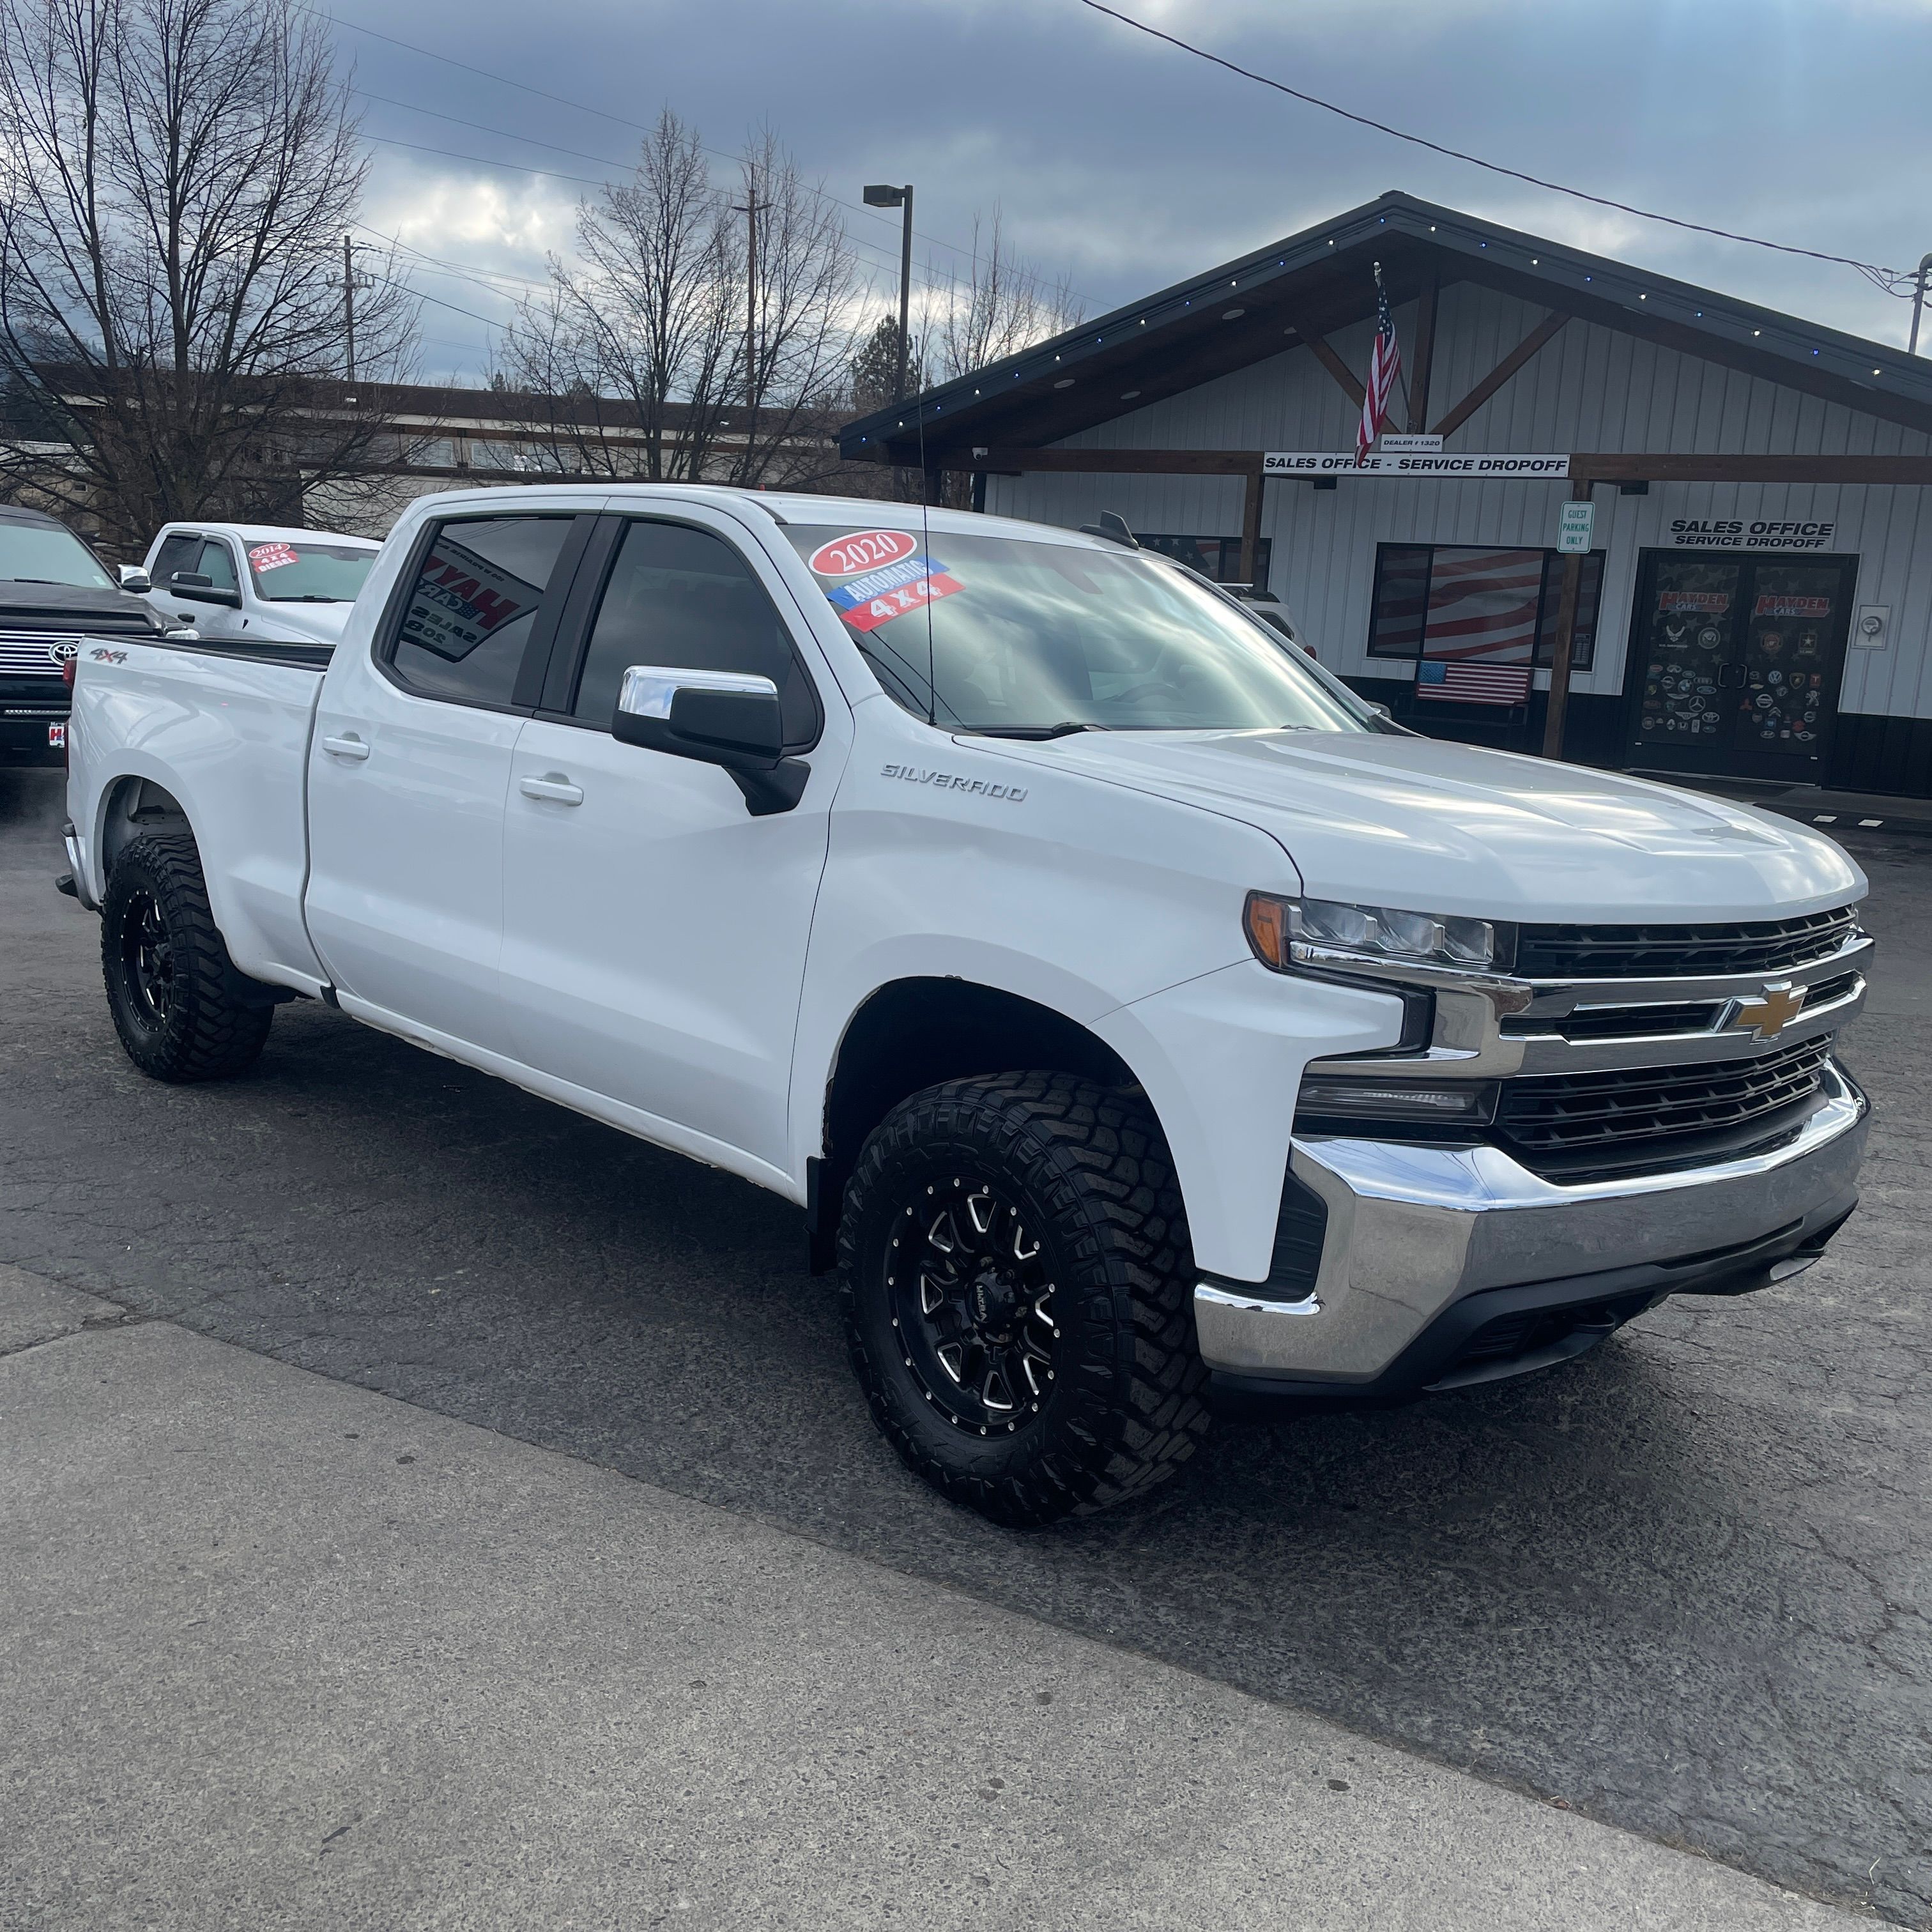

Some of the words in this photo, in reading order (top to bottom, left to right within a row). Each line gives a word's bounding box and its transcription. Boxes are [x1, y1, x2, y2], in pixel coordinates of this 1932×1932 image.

[1264, 457, 1317, 469] SALES
[1321, 458, 1382, 470] OFFICE
[1398, 458, 1475, 471] SERVICE
[1478, 459, 1568, 471] DROPOFF
[1568, 510, 1588, 519] GUEST
[1563, 523, 1590, 532] PARKING
[1670, 519, 1744, 534] SALES
[1749, 521, 1834, 536] OFFICE
[1566, 536, 1583, 545] ONLY
[1675, 535, 1744, 546] SERVICE
[1746, 537, 1826, 548] DROPOFF
[252, 543, 282, 558] 2014
[830, 533, 899, 572] 2020
[257, 557, 296, 572] DIESEL
[843, 560, 933, 602] AUTOMATIC
[1659, 592, 1729, 610] HAYDEN
[1675, 602, 1697, 611] CARS
[1756, 595, 1830, 614] HAYDEN
[880, 763, 1029, 802] SILVERADO
